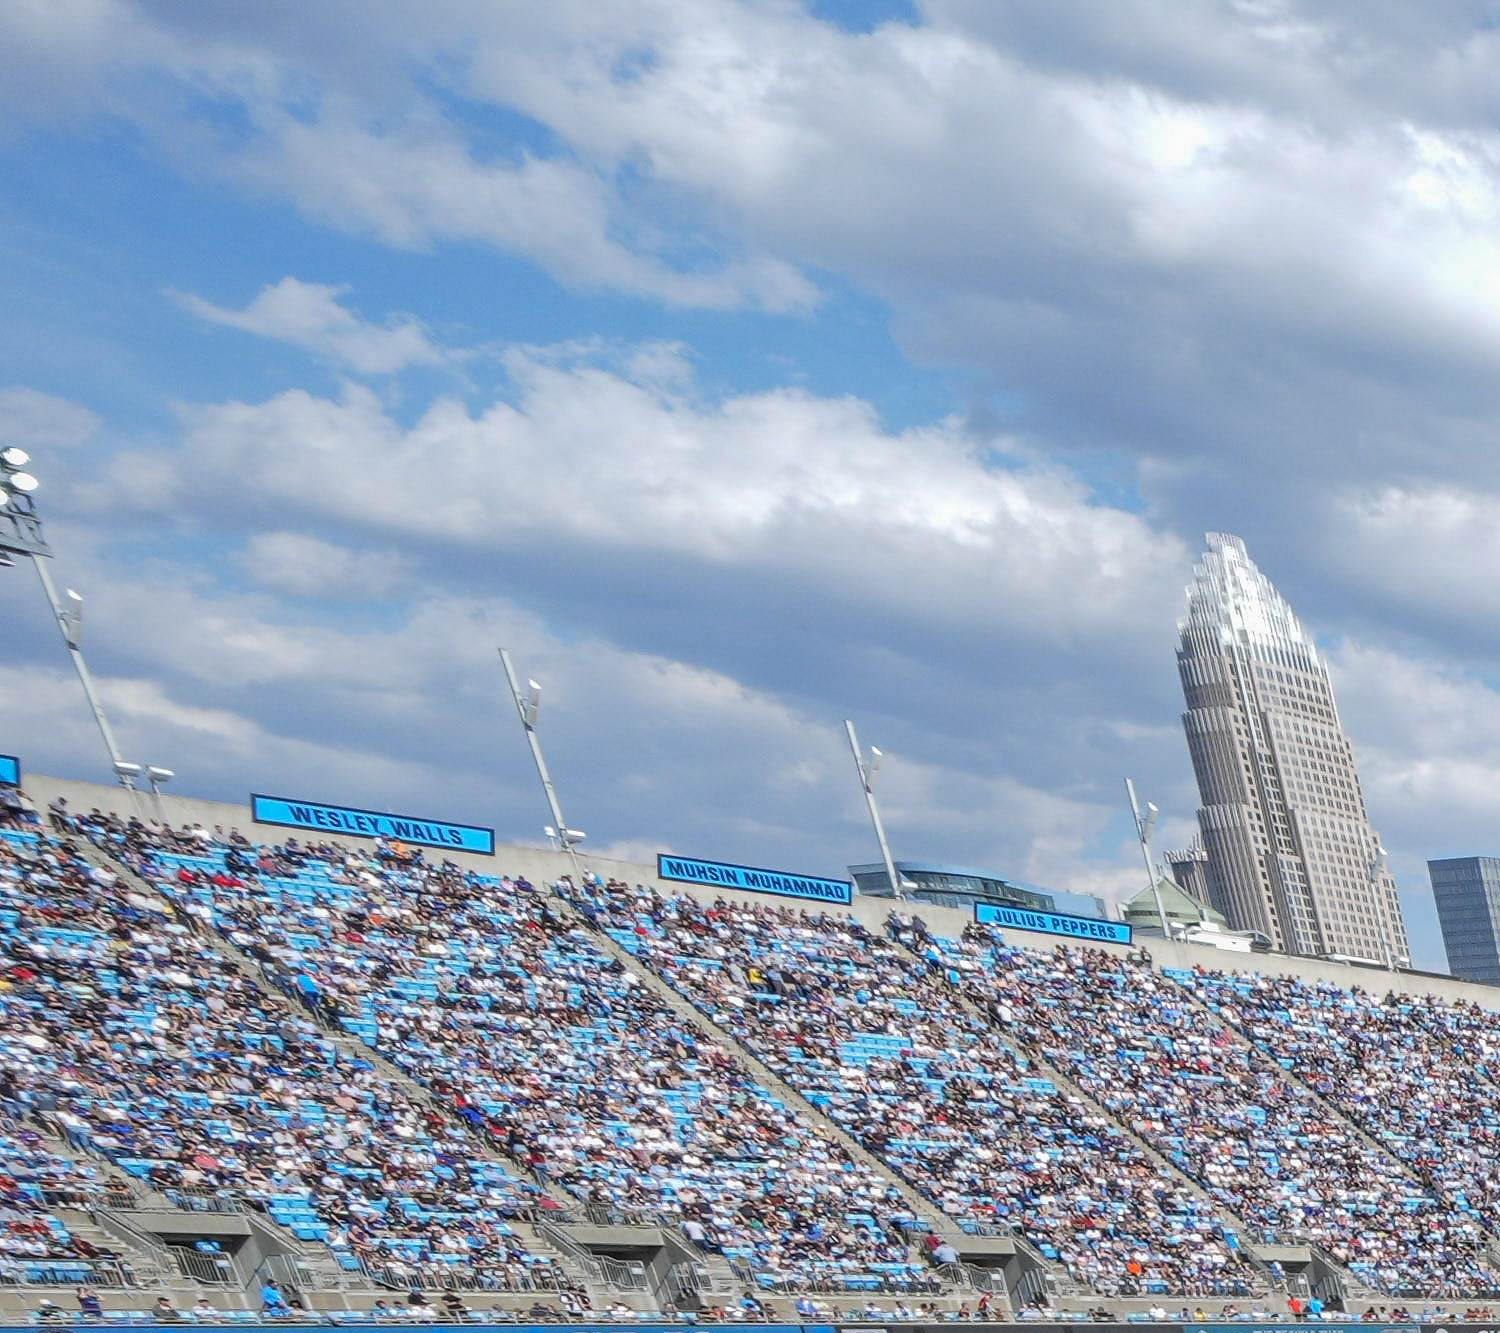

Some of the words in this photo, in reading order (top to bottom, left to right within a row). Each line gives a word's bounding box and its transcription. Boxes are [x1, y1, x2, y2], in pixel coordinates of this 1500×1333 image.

[287, 804, 381, 837] WESLEY
[388, 815, 464, 847] WALLS
[666, 860, 738, 886] MUHSIN
[744, 869, 846, 901] MUHAMMAD
[993, 907, 1046, 931] JULIUS
[1051, 915, 1118, 939] PEPPERS
